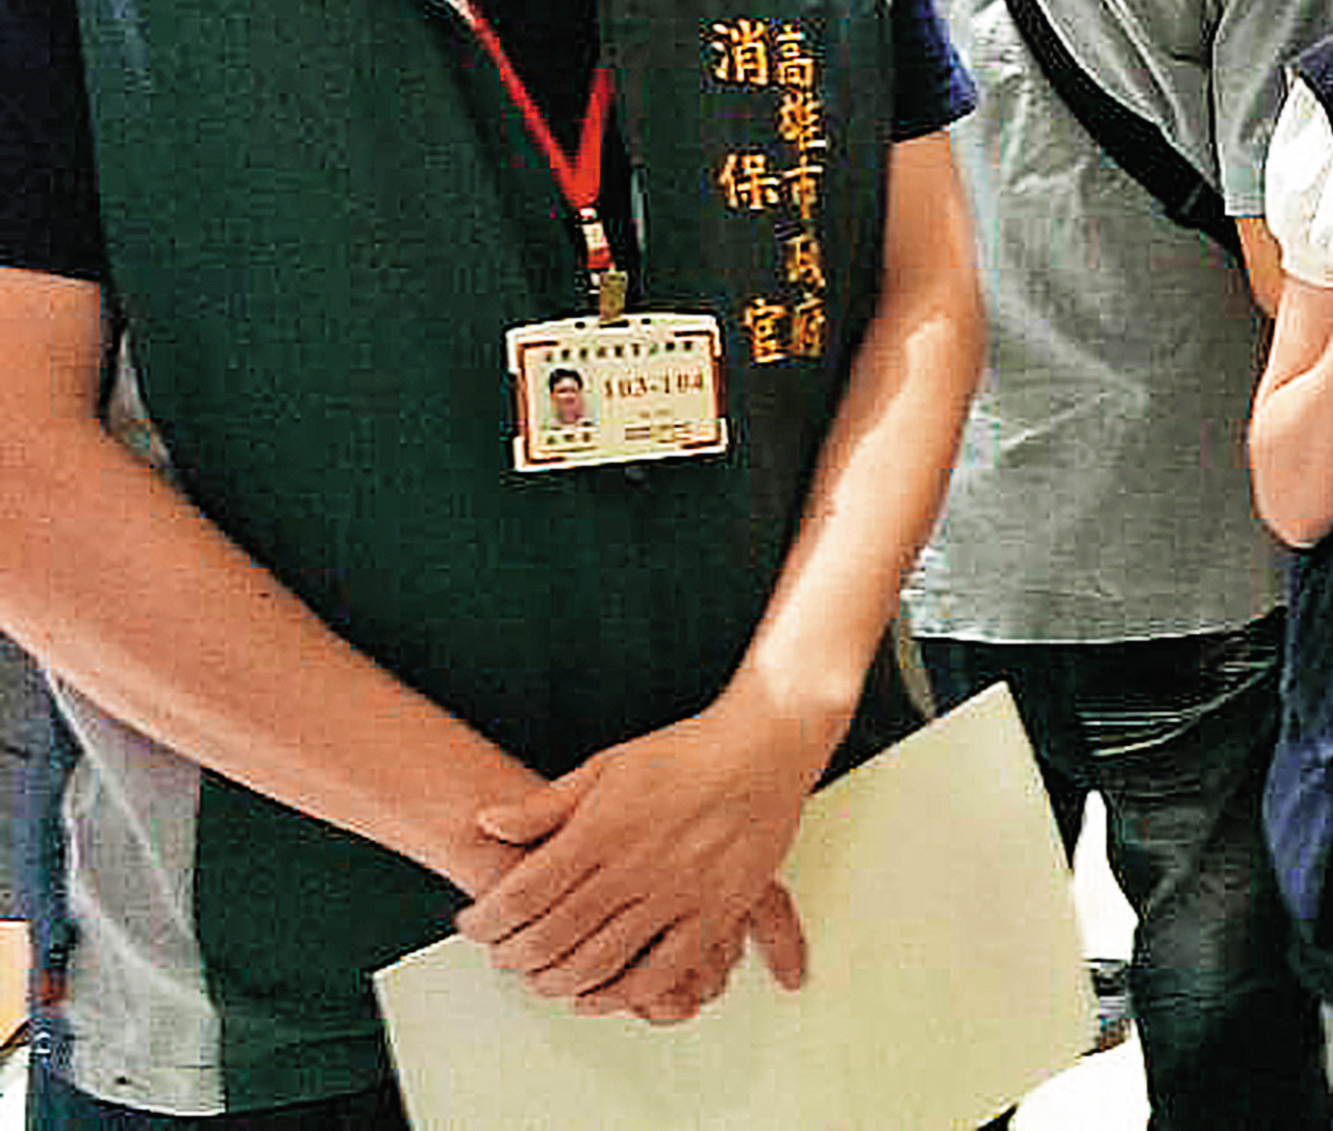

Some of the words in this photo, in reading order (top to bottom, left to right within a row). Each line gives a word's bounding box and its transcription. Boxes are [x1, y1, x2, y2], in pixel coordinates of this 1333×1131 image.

[711, 19, 792, 364] 消保官
[776, 22, 826, 357] 高雄市政府
